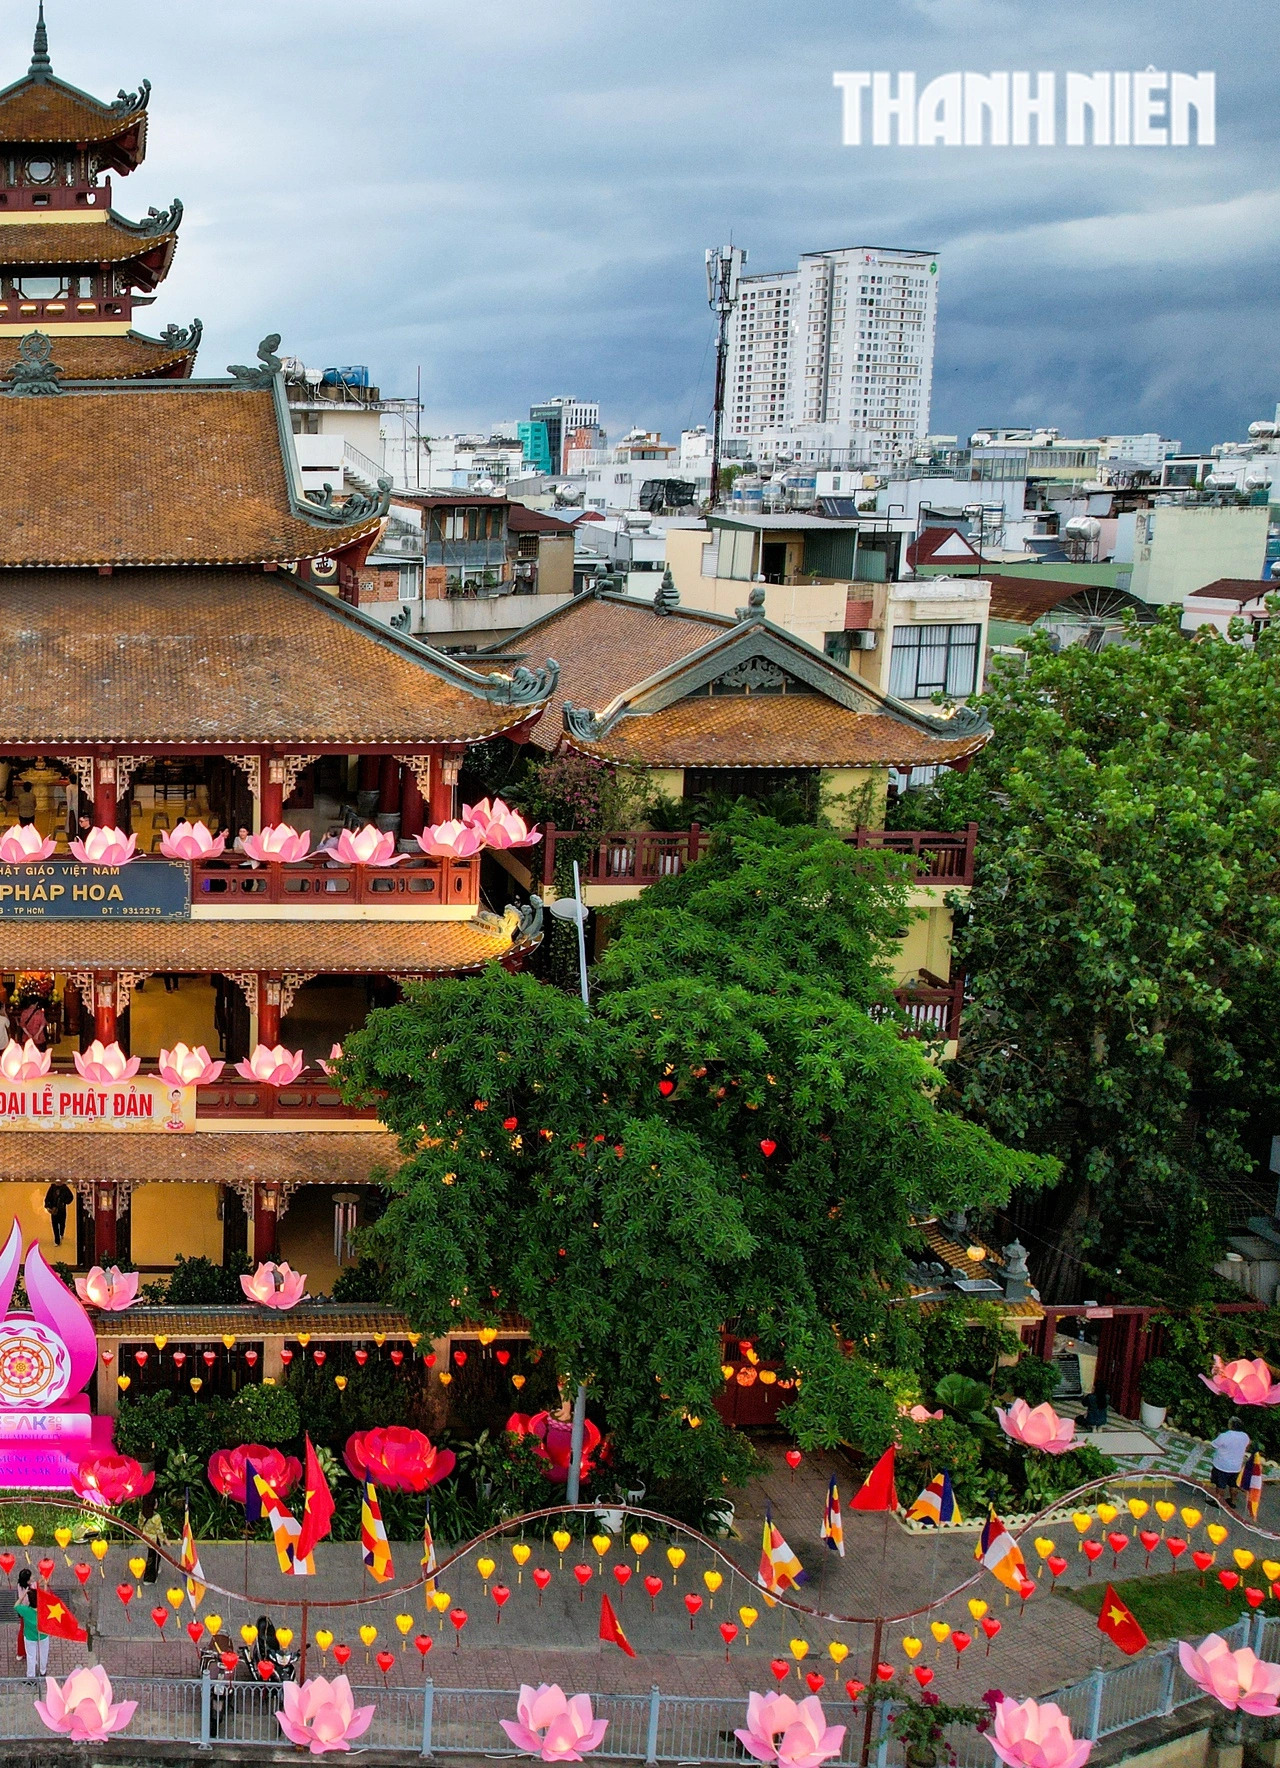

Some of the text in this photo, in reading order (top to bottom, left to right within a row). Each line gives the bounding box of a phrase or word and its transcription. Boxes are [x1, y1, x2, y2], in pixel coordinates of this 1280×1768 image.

[25, 864, 55, 876] GIÁO
[61, 864, 88, 878] VIỆT
[92, 866, 120, 876] NAM
[72, 884, 124, 901] HOA
[26, 906, 45, 915] HCM
[122, 906, 161, 915] 9312275
[32, 1083, 53, 1115] LỄ
[59, 1087, 108, 1121] PHẬT
[113, 1085, 153, 1117] ĐẢN
